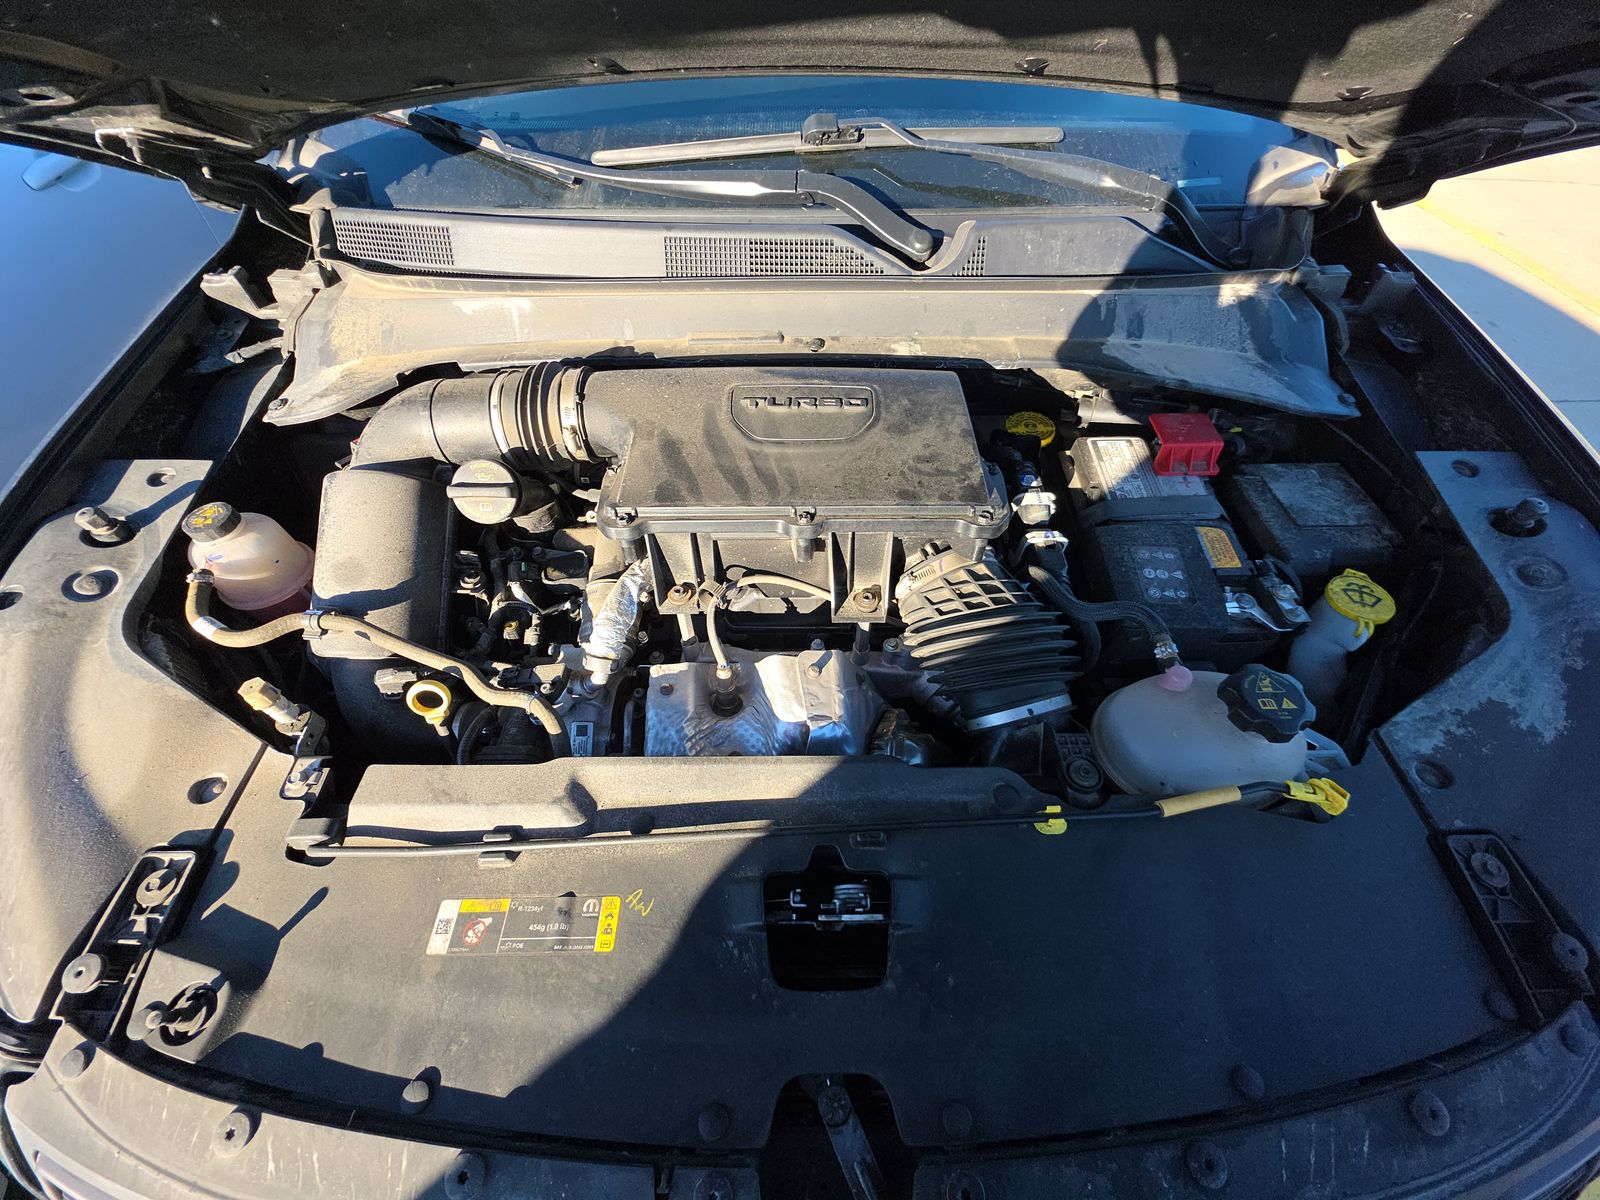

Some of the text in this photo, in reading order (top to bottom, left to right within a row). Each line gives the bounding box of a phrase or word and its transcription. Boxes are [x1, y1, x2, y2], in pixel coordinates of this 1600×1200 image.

[740, 397, 869, 410] TURBO
[528, 923, 569, 932] 454g (1.0 lb)
